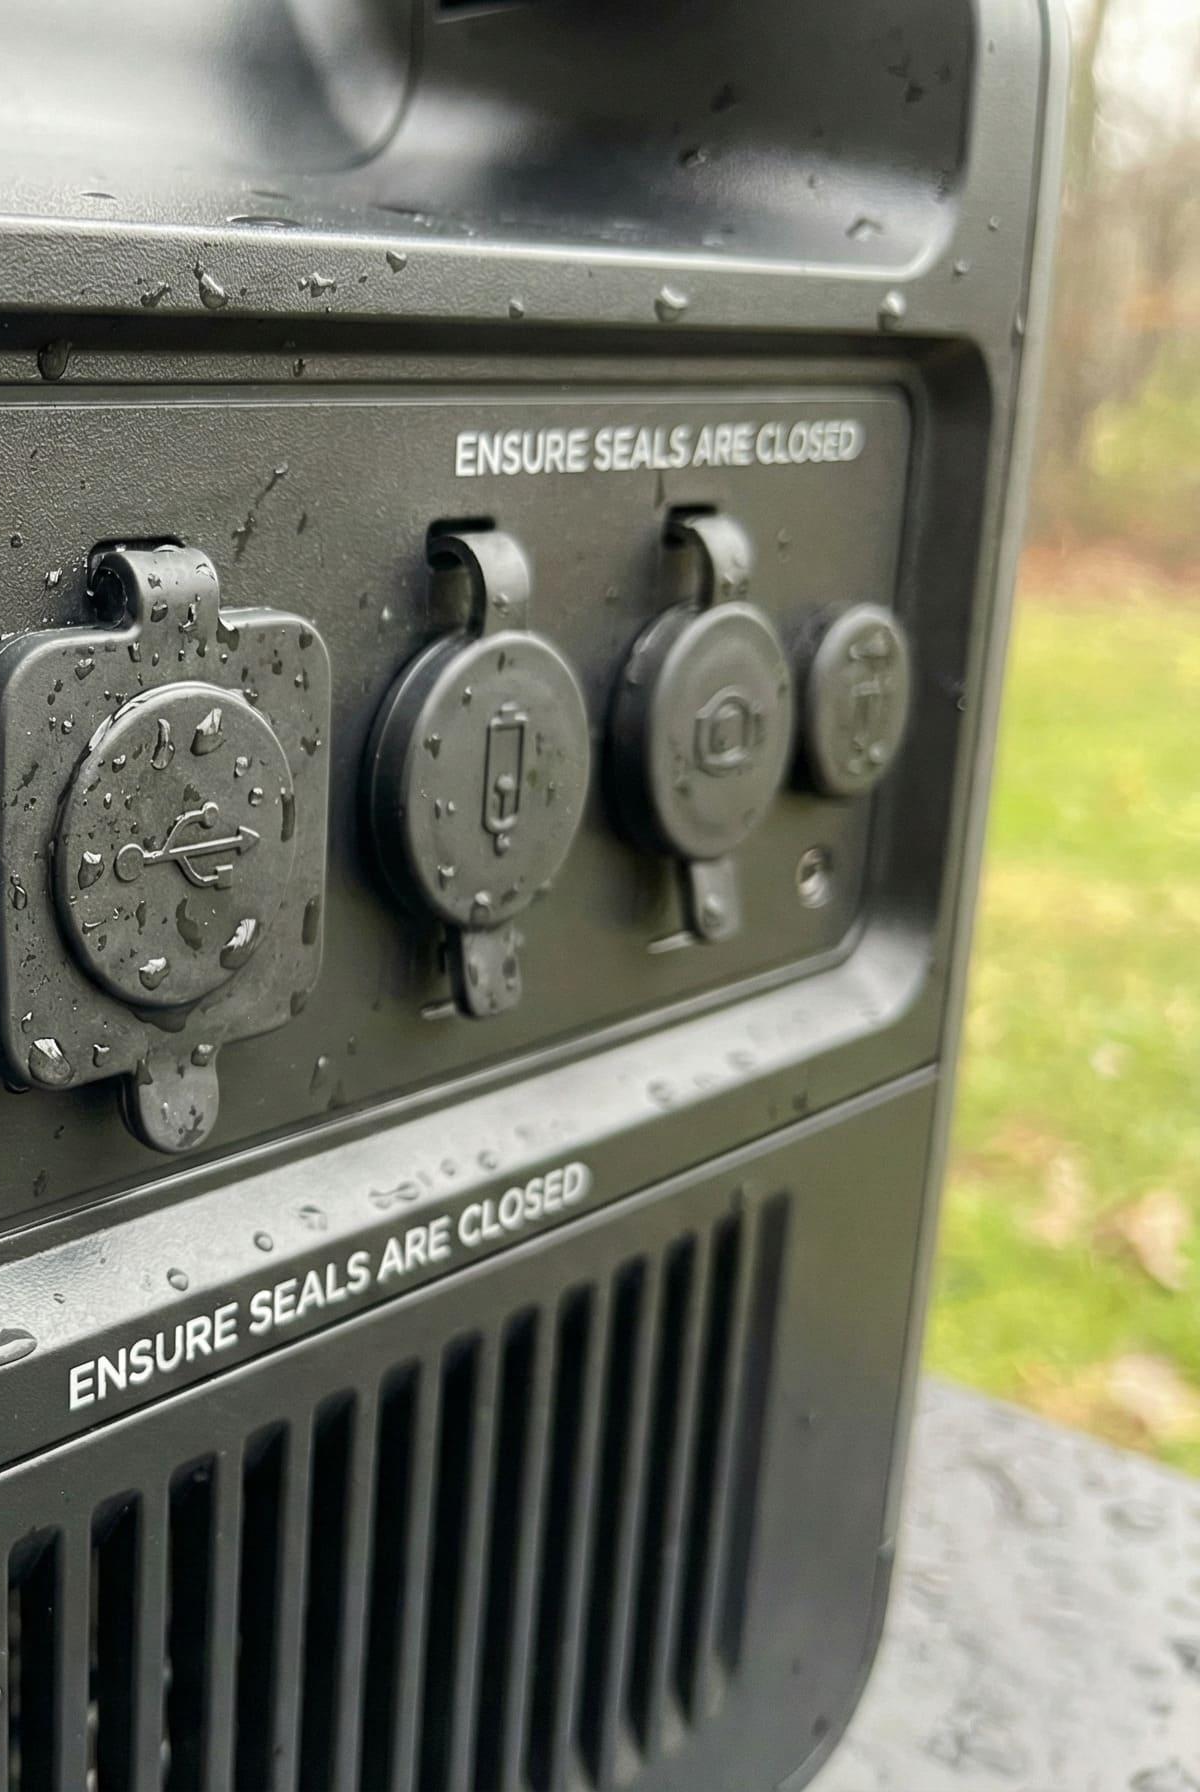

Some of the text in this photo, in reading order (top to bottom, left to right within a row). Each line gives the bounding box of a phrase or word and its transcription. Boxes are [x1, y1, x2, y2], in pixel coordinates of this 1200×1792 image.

[455, 419, 865, 477] ENSURE SEALS ARE CLOSED
[68, 1161, 593, 1411] ENSURE SEALS ARE CLOSED
